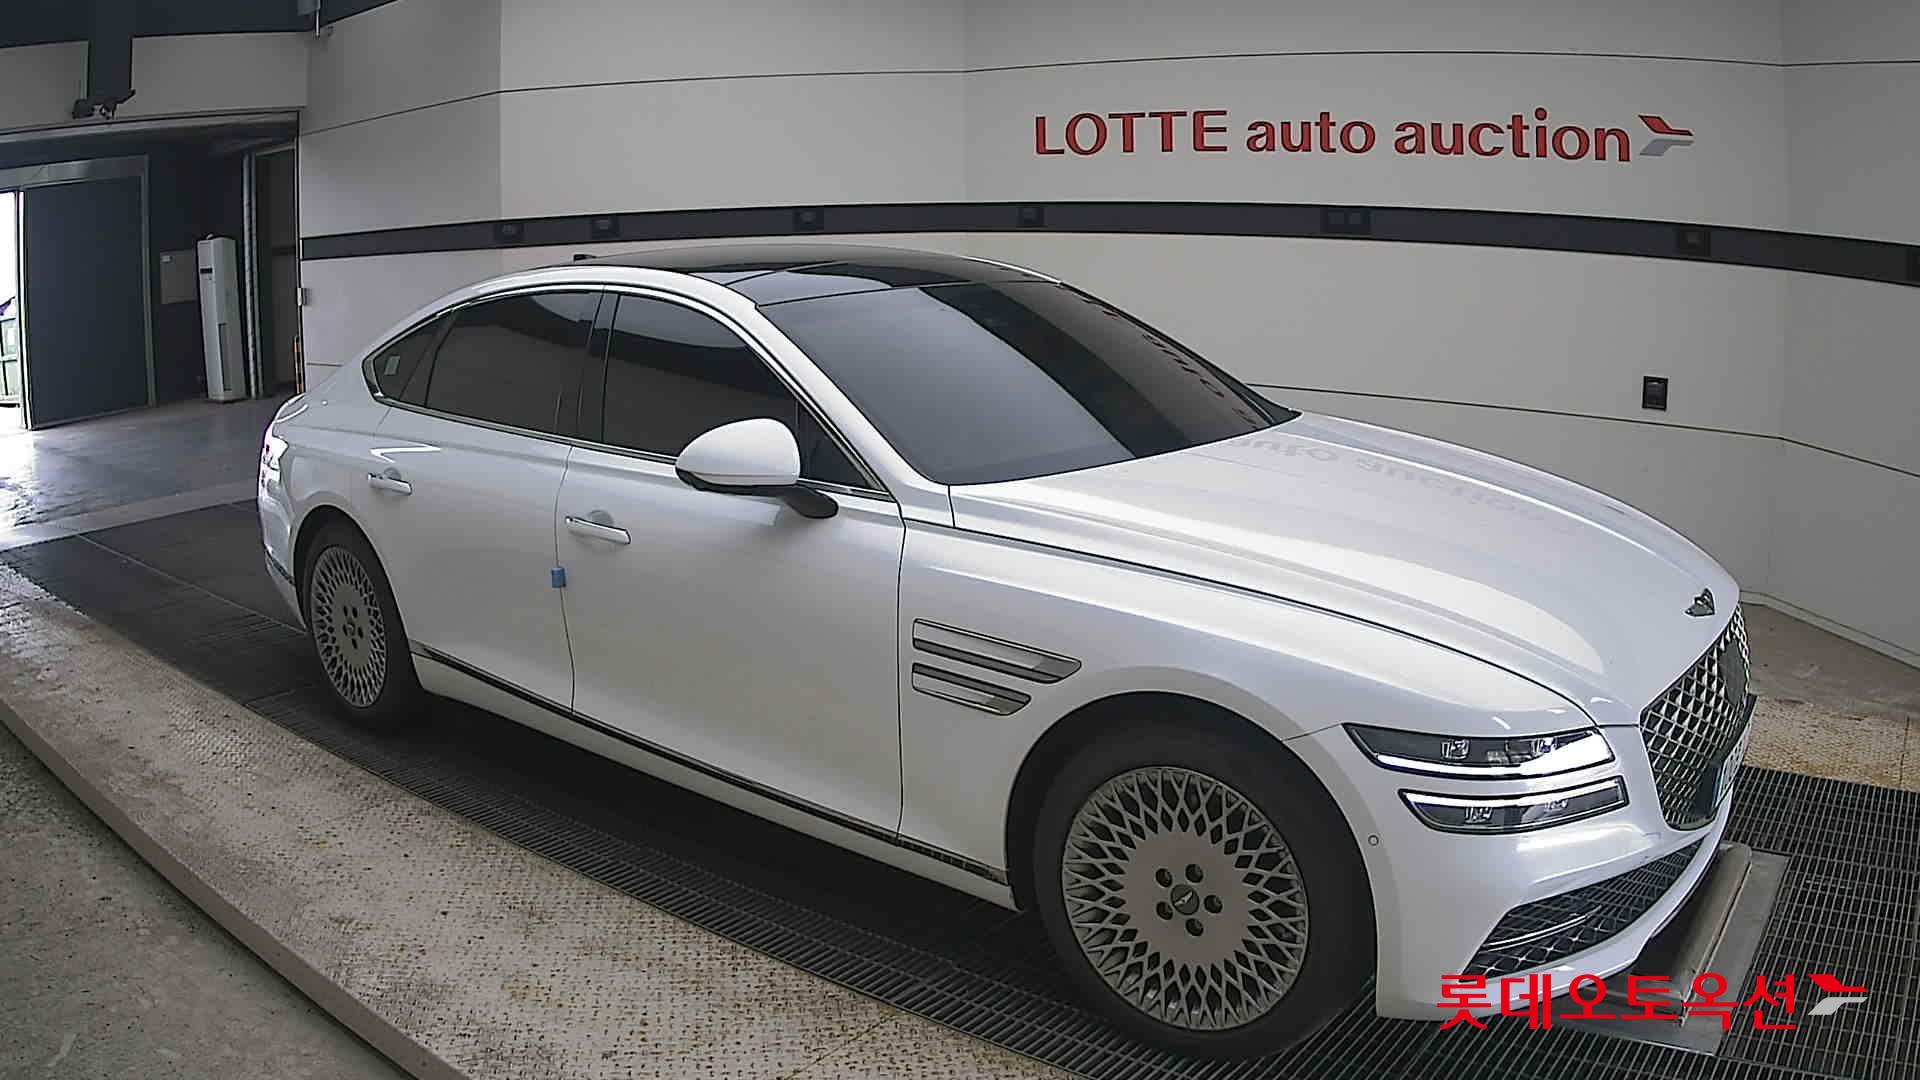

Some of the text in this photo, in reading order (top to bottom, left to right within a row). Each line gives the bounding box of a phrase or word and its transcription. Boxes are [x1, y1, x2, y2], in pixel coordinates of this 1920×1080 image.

[1034, 107, 1631, 161] LOTTE auto auction
